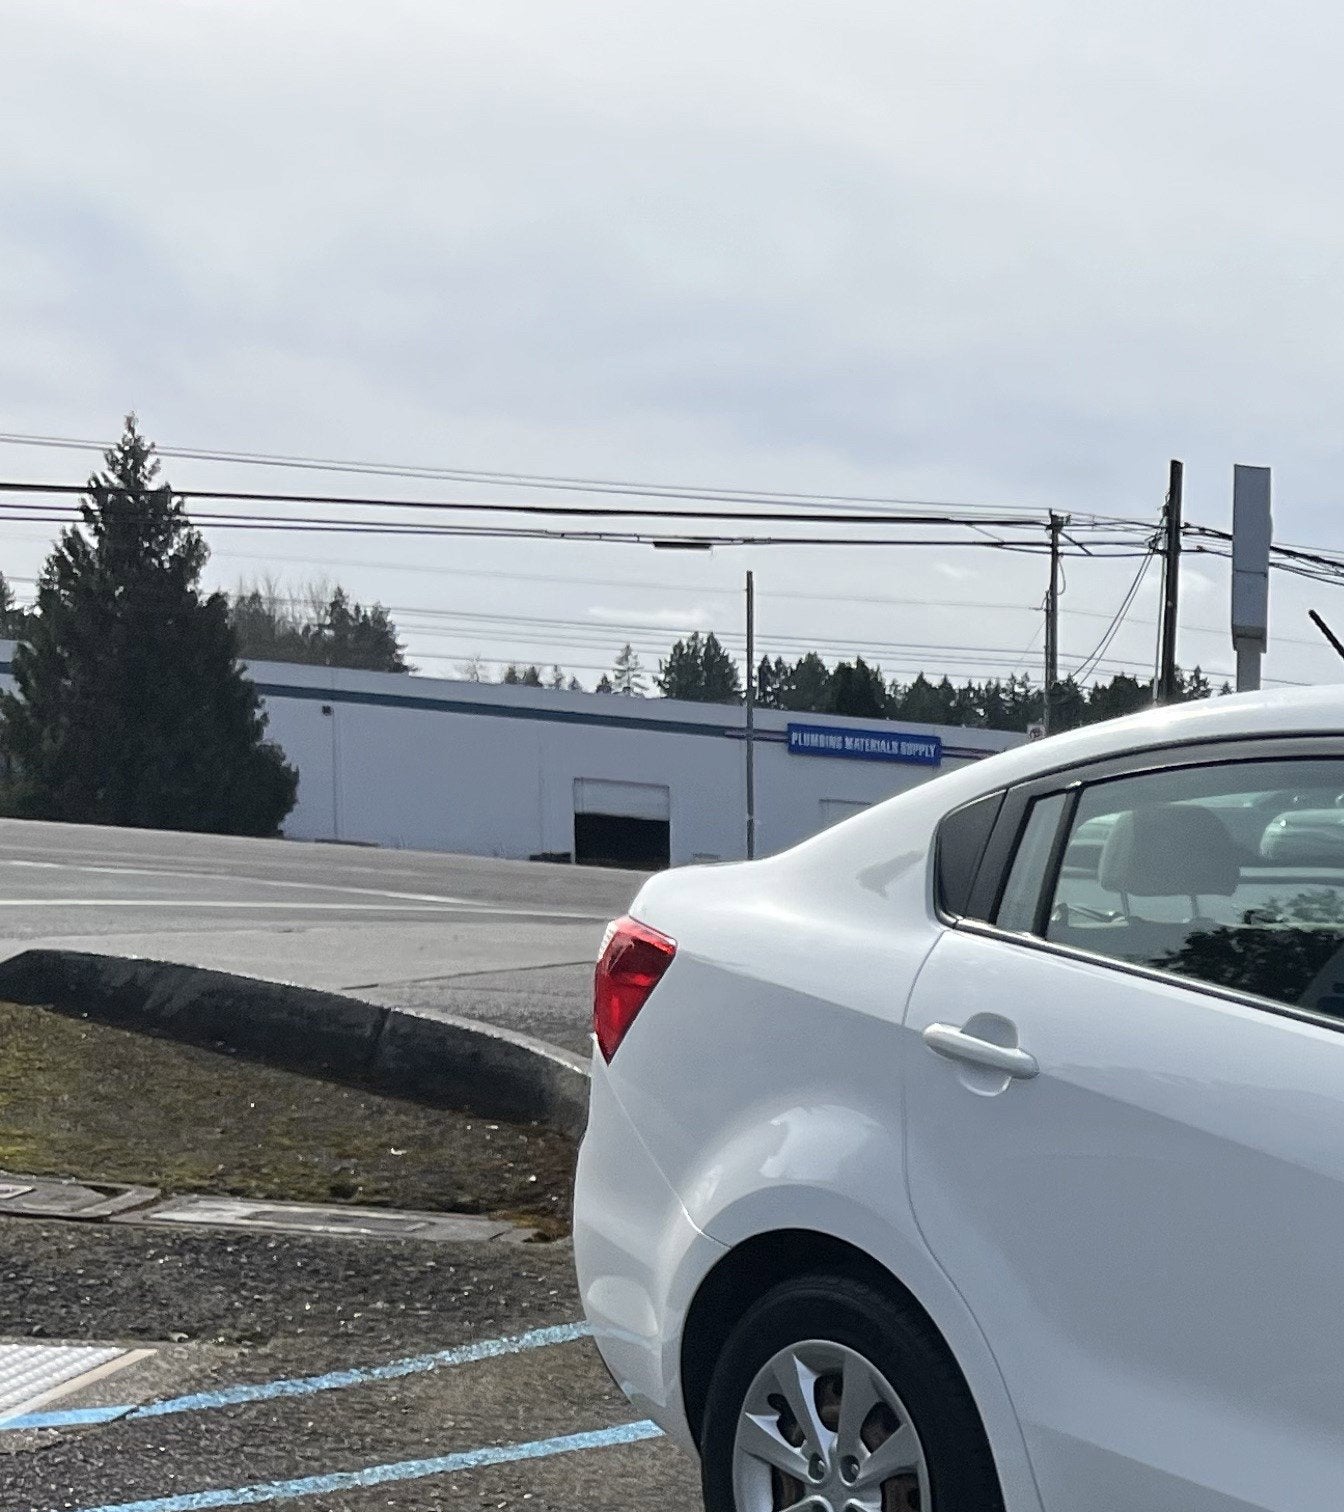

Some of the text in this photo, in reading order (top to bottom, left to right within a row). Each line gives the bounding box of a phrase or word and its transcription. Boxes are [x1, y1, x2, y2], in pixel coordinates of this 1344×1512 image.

[791, 731, 937, 758] PLUMBING MATERIALS SUPPLY
